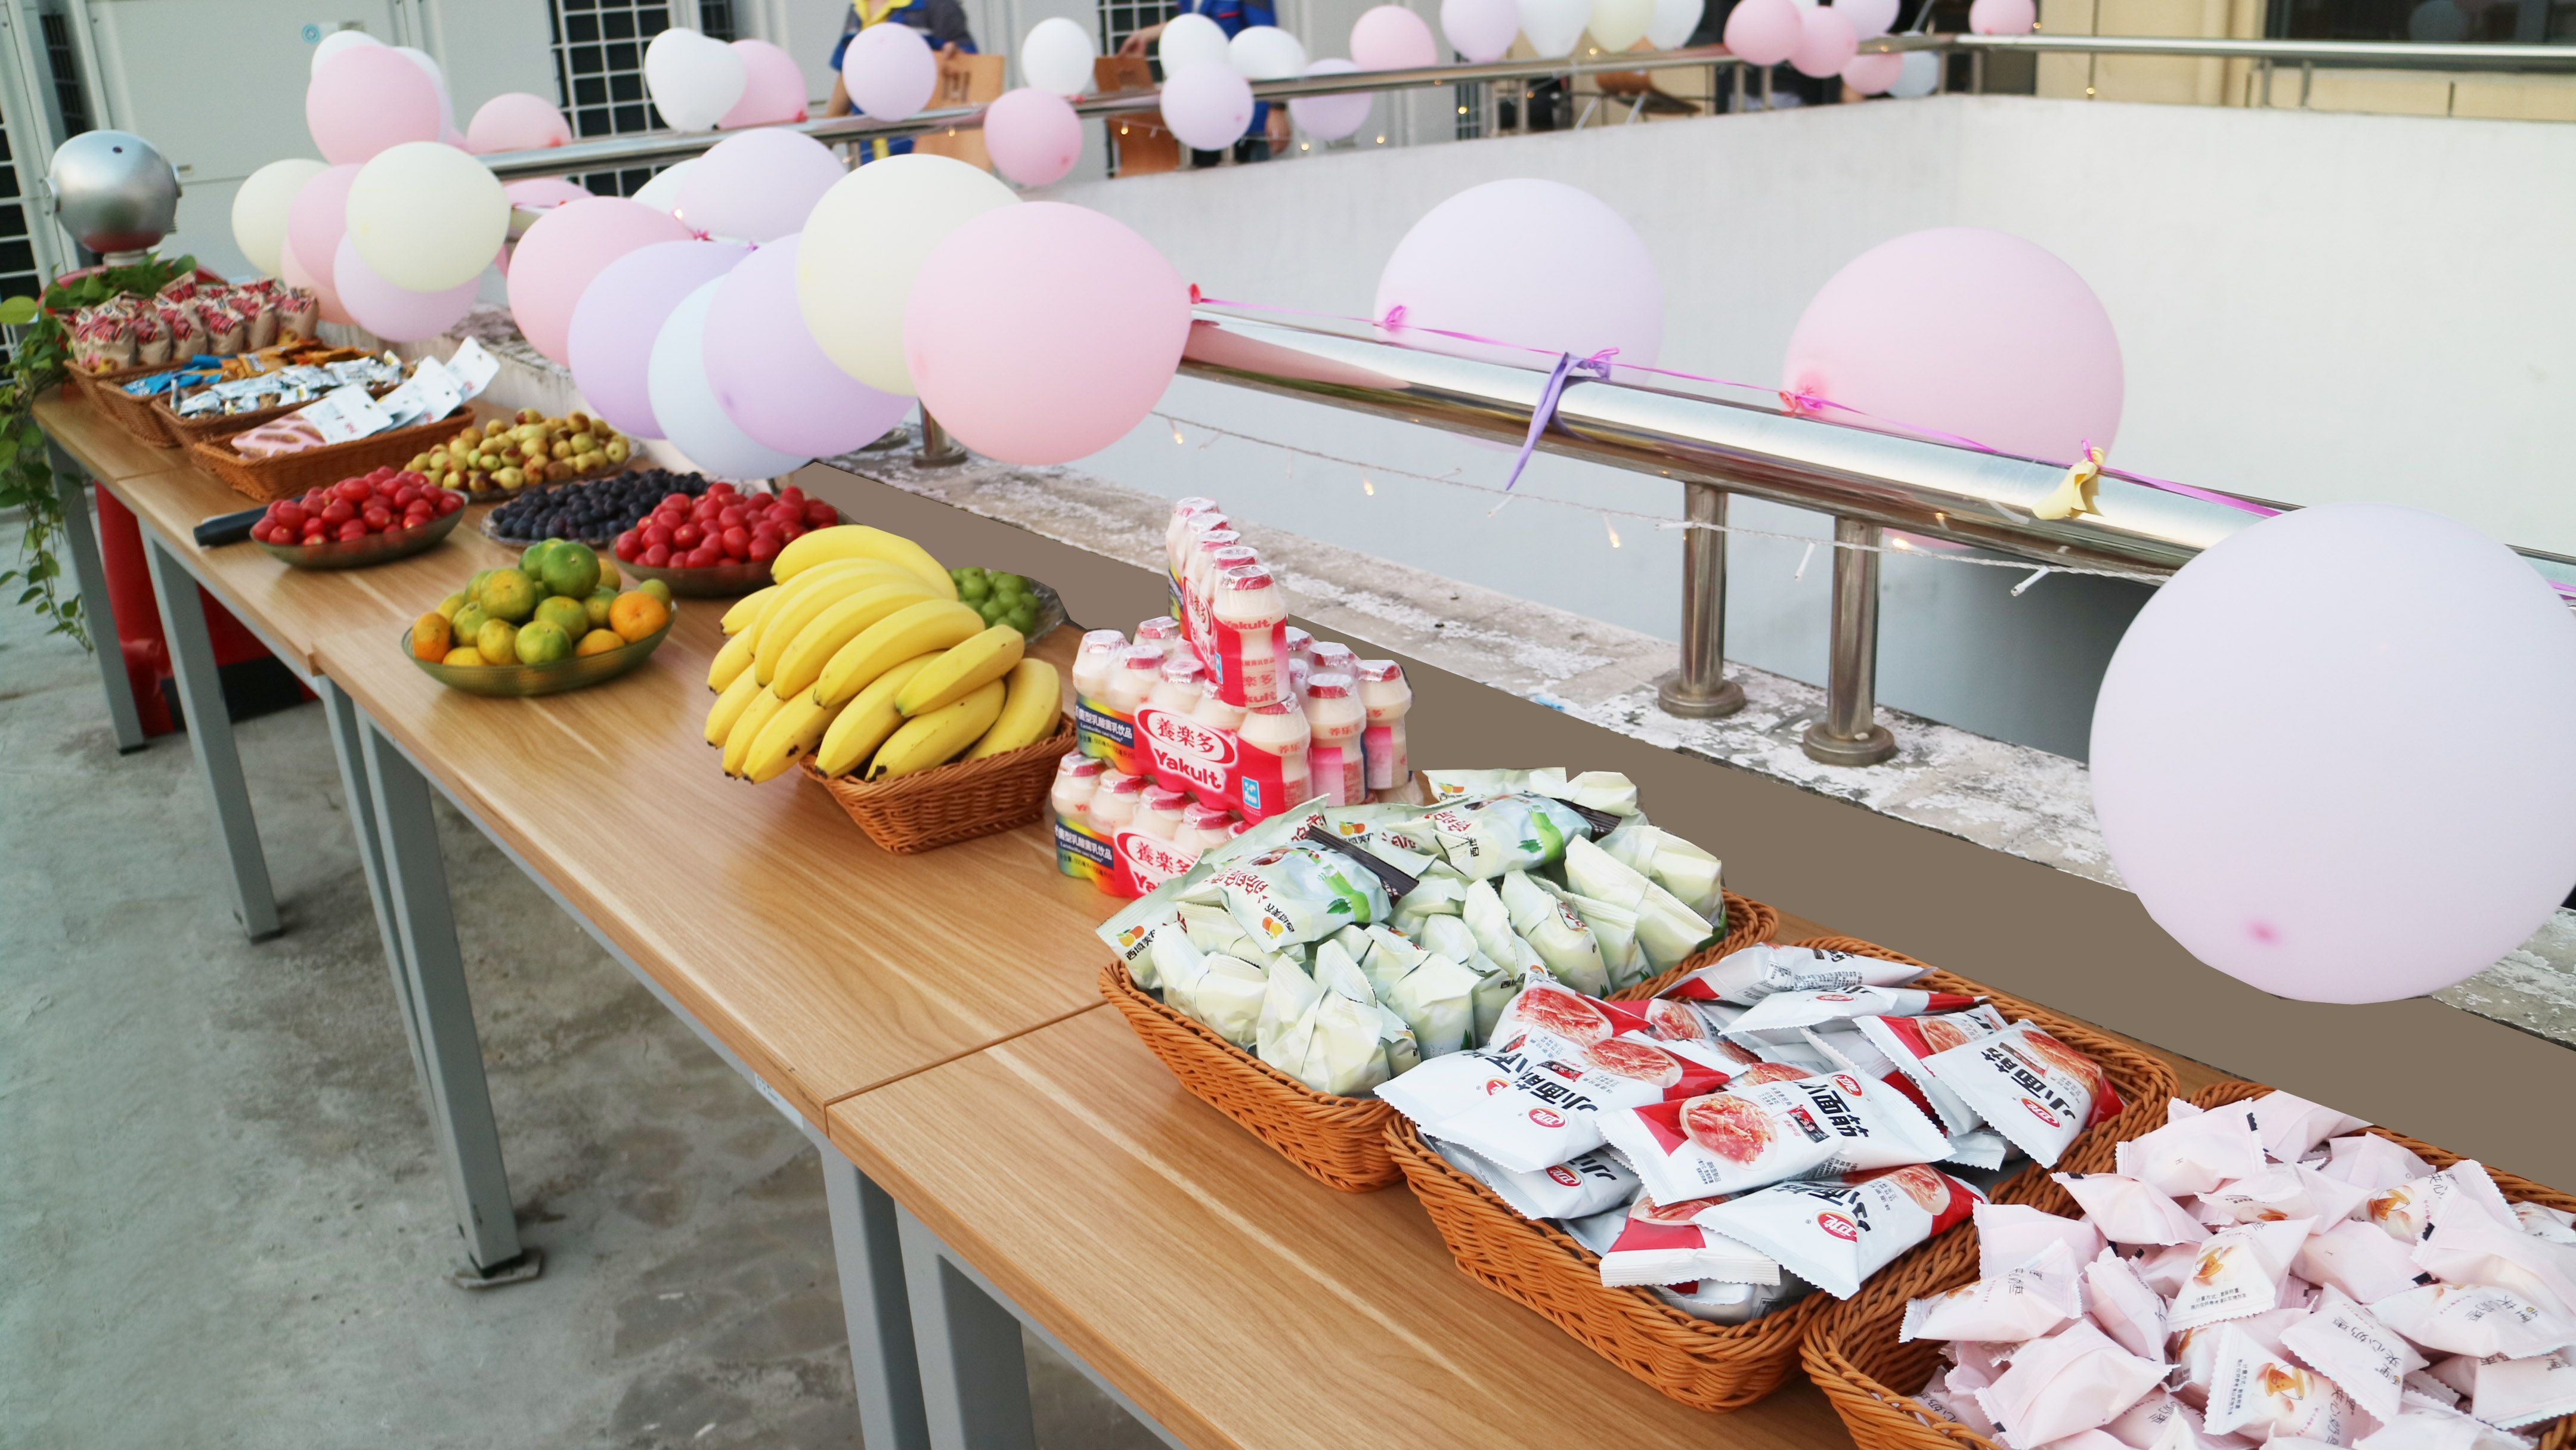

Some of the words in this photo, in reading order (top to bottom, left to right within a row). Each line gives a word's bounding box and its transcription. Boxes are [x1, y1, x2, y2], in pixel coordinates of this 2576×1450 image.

[1154, 748, 1222, 789] Yakult
[1981, 1047, 2076, 1120] 小面筋
